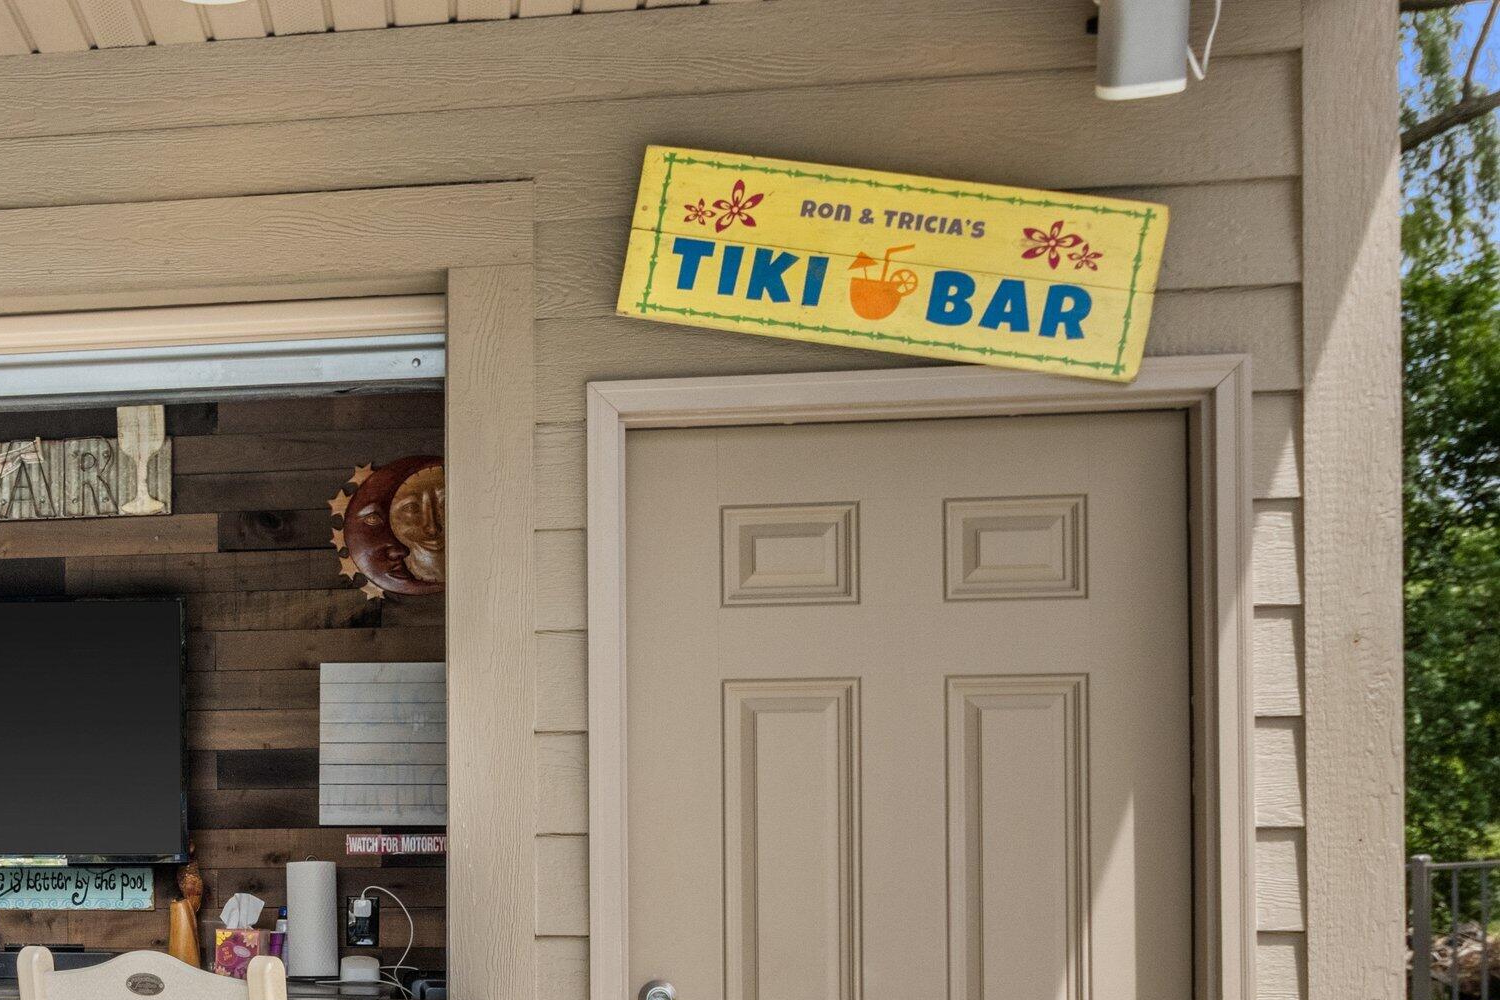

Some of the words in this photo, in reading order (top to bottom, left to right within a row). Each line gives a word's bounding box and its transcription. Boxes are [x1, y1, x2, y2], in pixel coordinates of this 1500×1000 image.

[858, 208, 875, 225] &
[884, 209, 986, 239] TRICIA'S
[672, 237, 830, 307] TIKI
[925, 269, 1093, 341] BAR
[349, 836, 379, 852] WATCH
[381, 836, 399, 852] FOR
[26, 869, 72, 892] better
[72, 870, 90, 906] by
[94, 868, 116, 891] the
